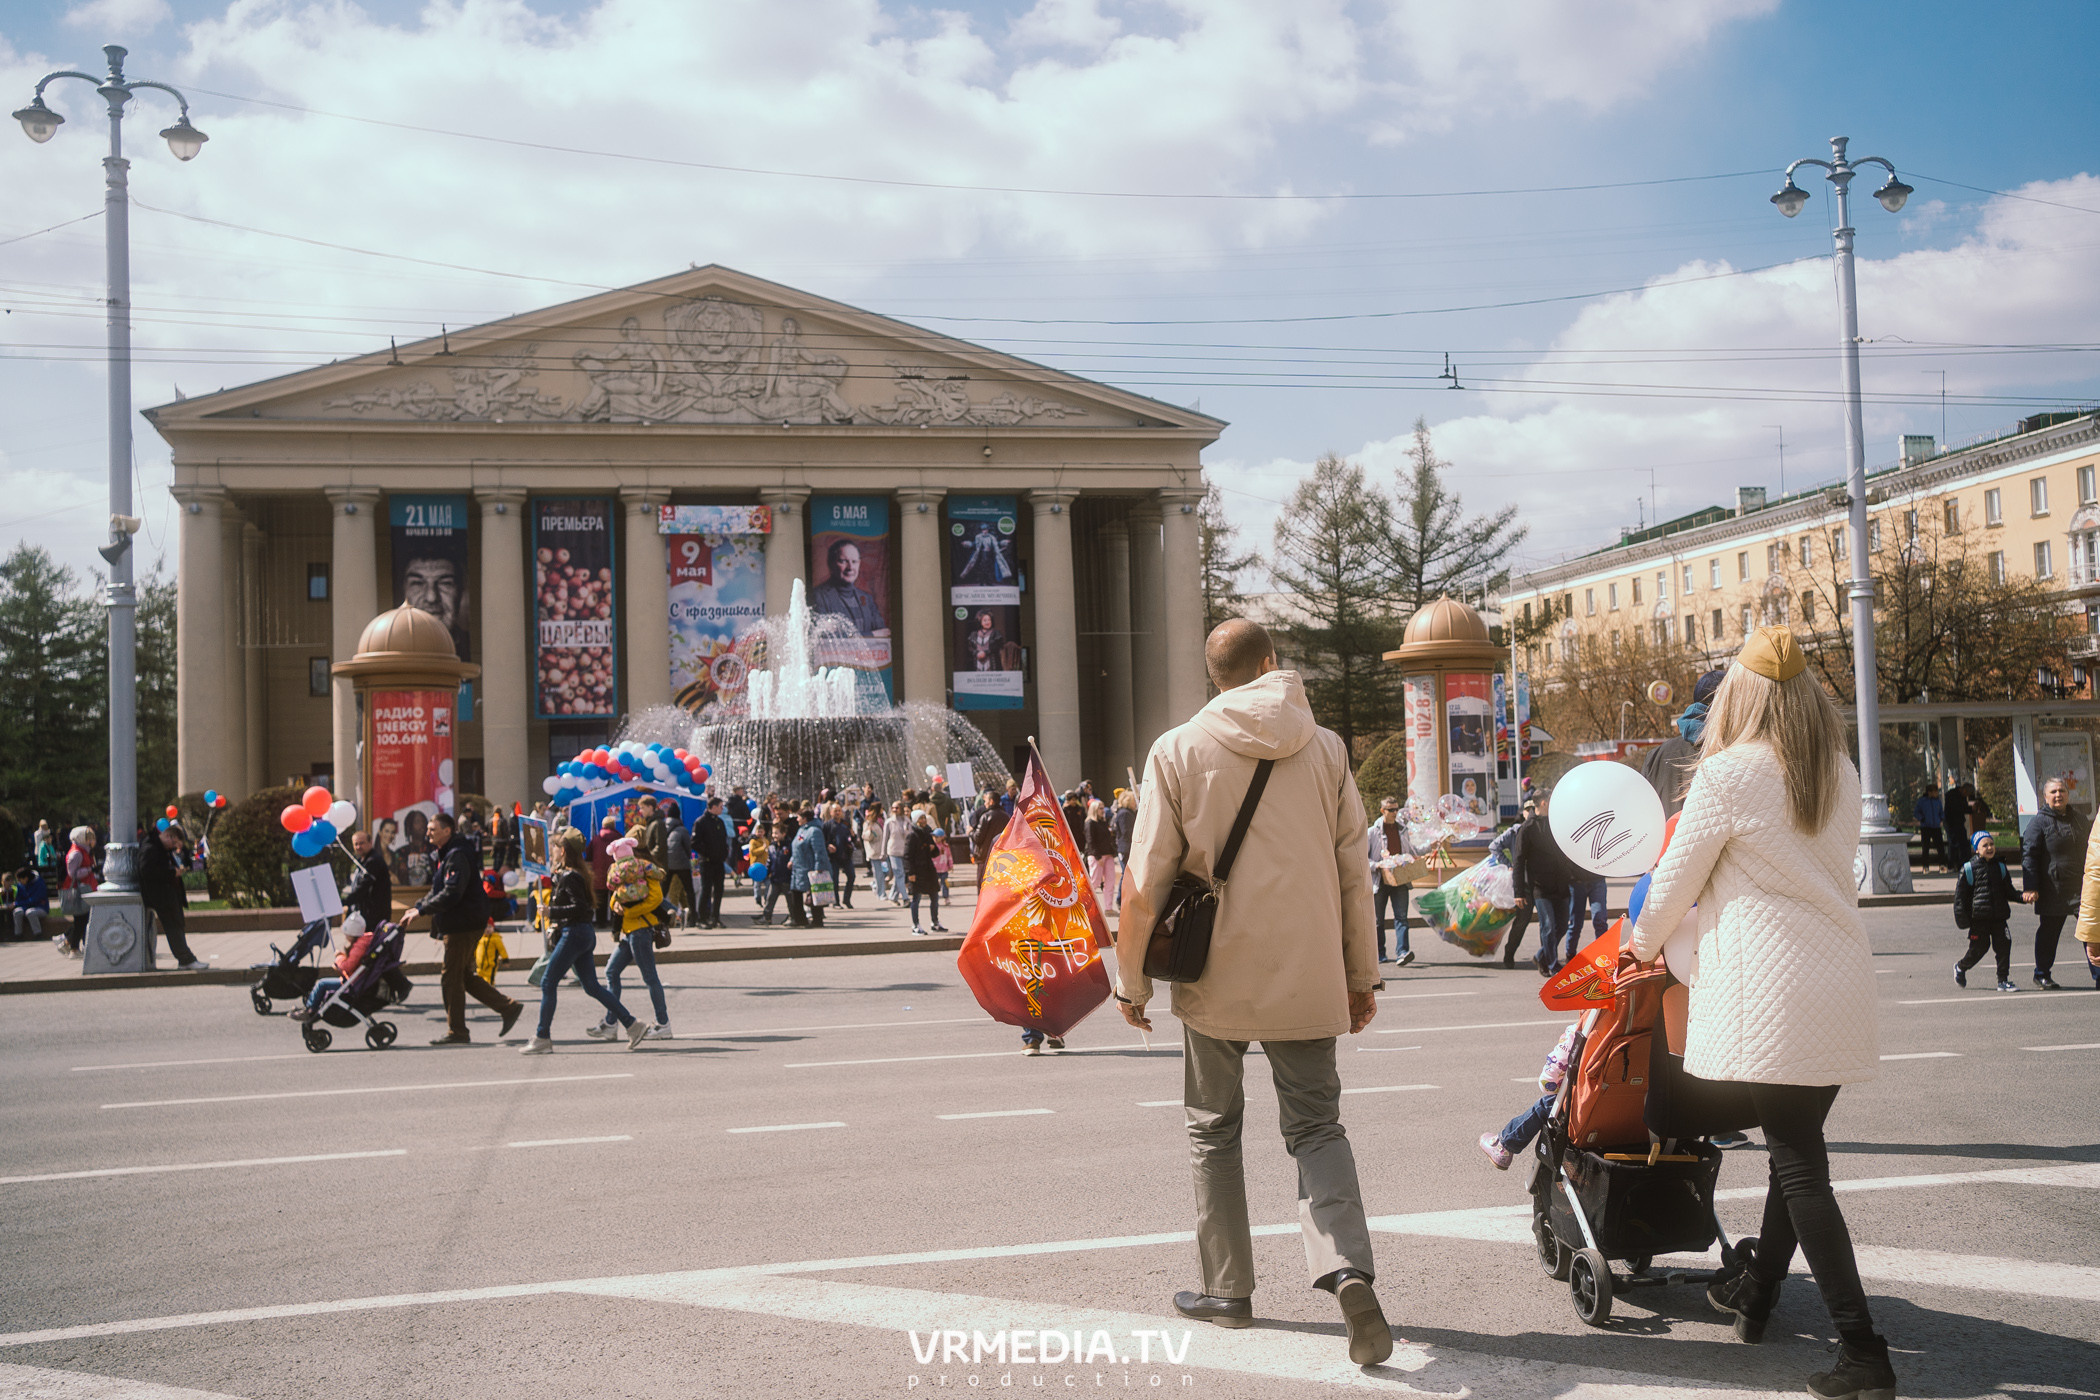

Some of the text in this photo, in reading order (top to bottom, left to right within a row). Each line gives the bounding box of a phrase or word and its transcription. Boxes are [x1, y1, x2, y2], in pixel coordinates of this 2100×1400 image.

[405, 505, 452, 527] 21 МАЯ
[833, 505, 868, 520] 6 МАЯ
[541, 515, 605, 532] ПРЕМЬЕРА
[681, 540, 701, 565] 9
[676, 566, 707, 577] мая
[670, 602, 766, 621] С праздником!
[542, 621, 610, 647] ЦАРЁВЫ
[375, 706, 425, 720] РАДИО
[1416, 698, 1432, 740] 102.8
[376, 719, 428, 733] ENERGY
